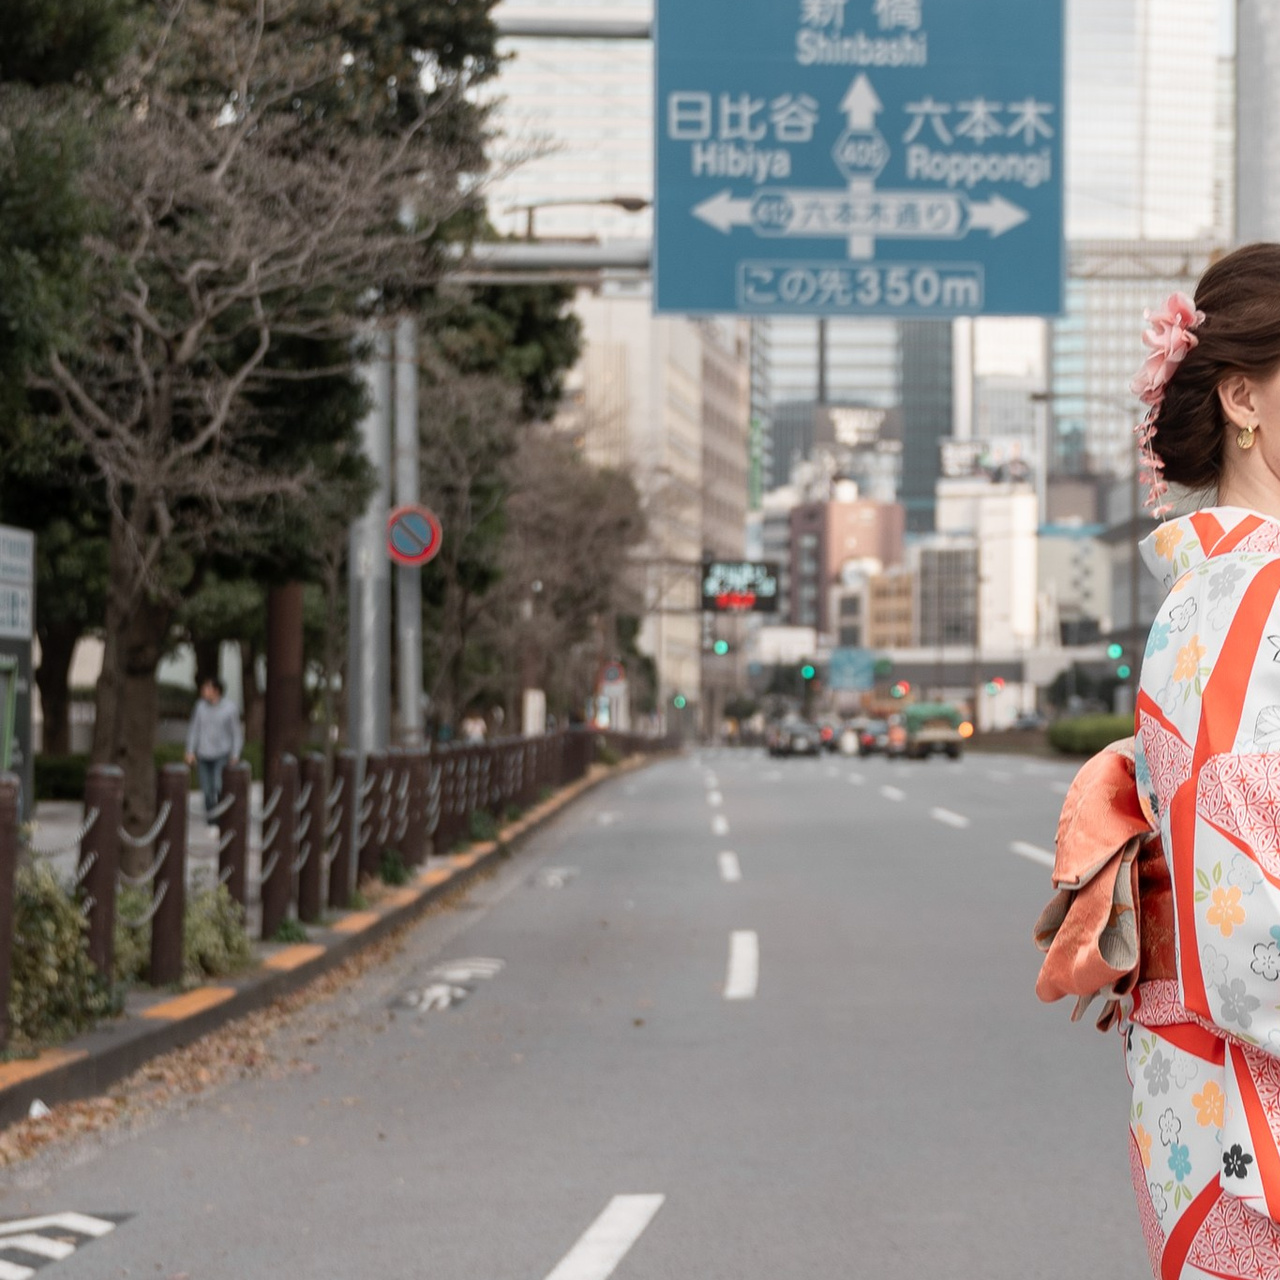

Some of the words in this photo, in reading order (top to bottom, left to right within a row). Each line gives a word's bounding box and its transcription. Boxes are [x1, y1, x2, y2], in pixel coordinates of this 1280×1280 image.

[795, 31, 928, 67] Shinbashi
[668, 91, 819, 141] 日比谷
[903, 97, 1054, 146] 六本木
[690, 144, 792, 183] Hibiya
[906, 144, 1052, 188] Roppongi
[744, 265, 980, 308] この先350m
